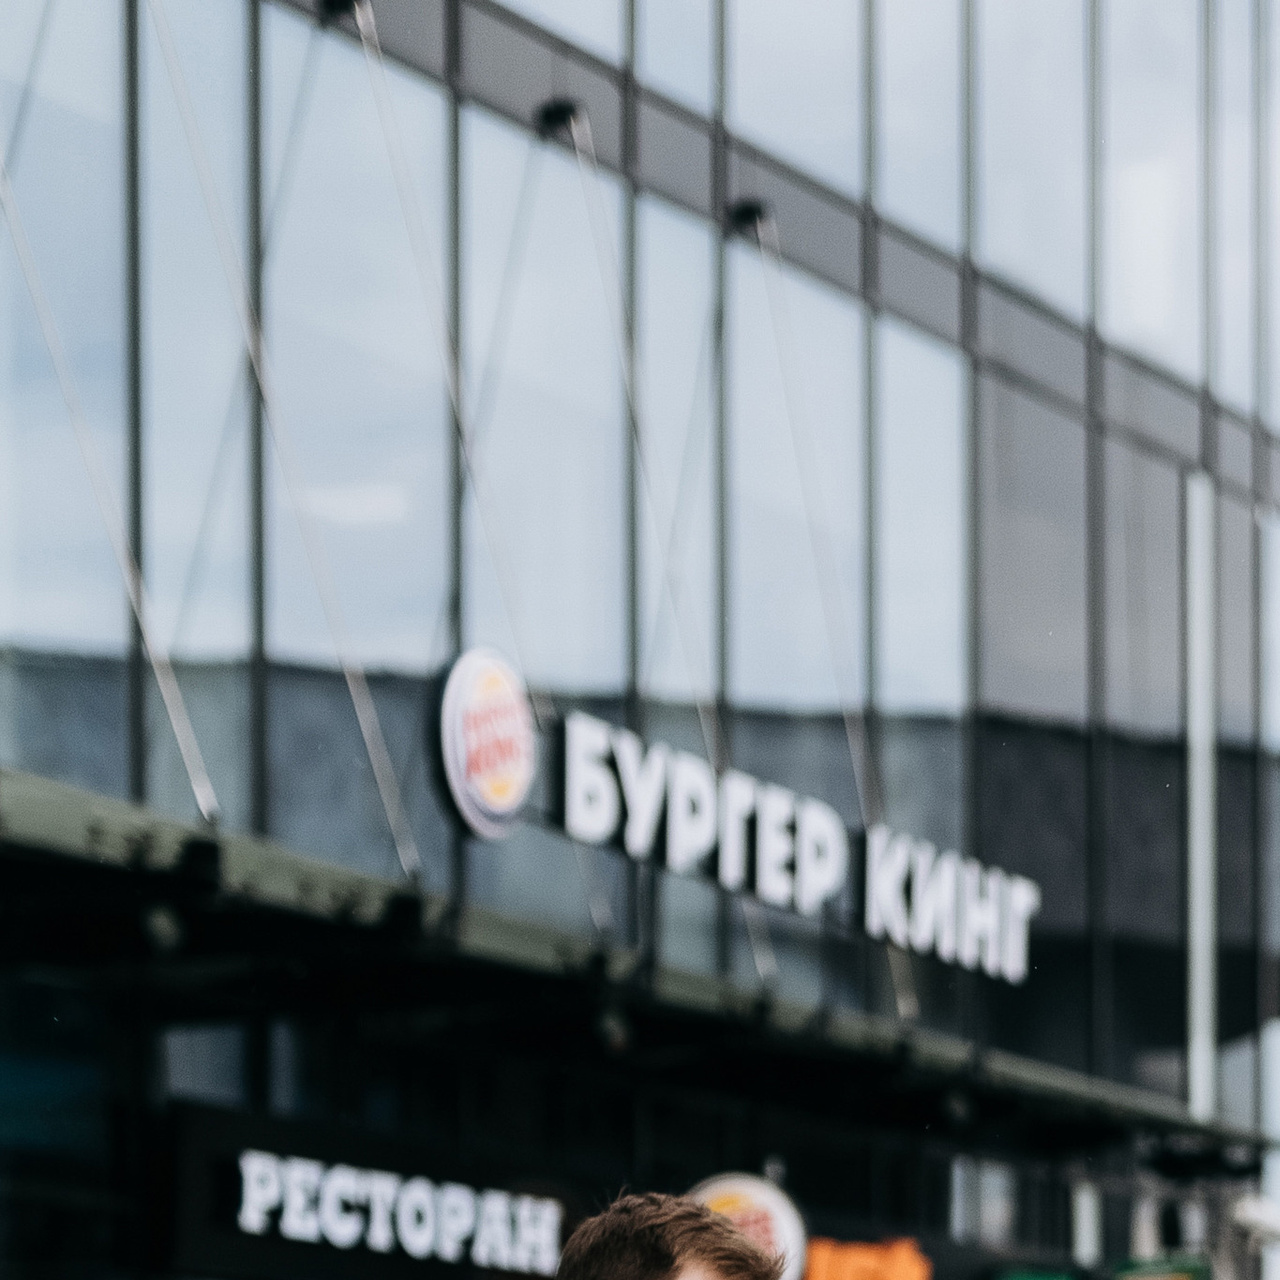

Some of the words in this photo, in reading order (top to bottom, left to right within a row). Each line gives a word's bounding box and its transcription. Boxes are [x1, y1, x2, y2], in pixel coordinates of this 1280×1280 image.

[564, 709, 849, 918] БУРГЕР
[863, 823, 1041, 986] КИНГ
[237, 1147, 564, 1278] РЕСТОРАН
